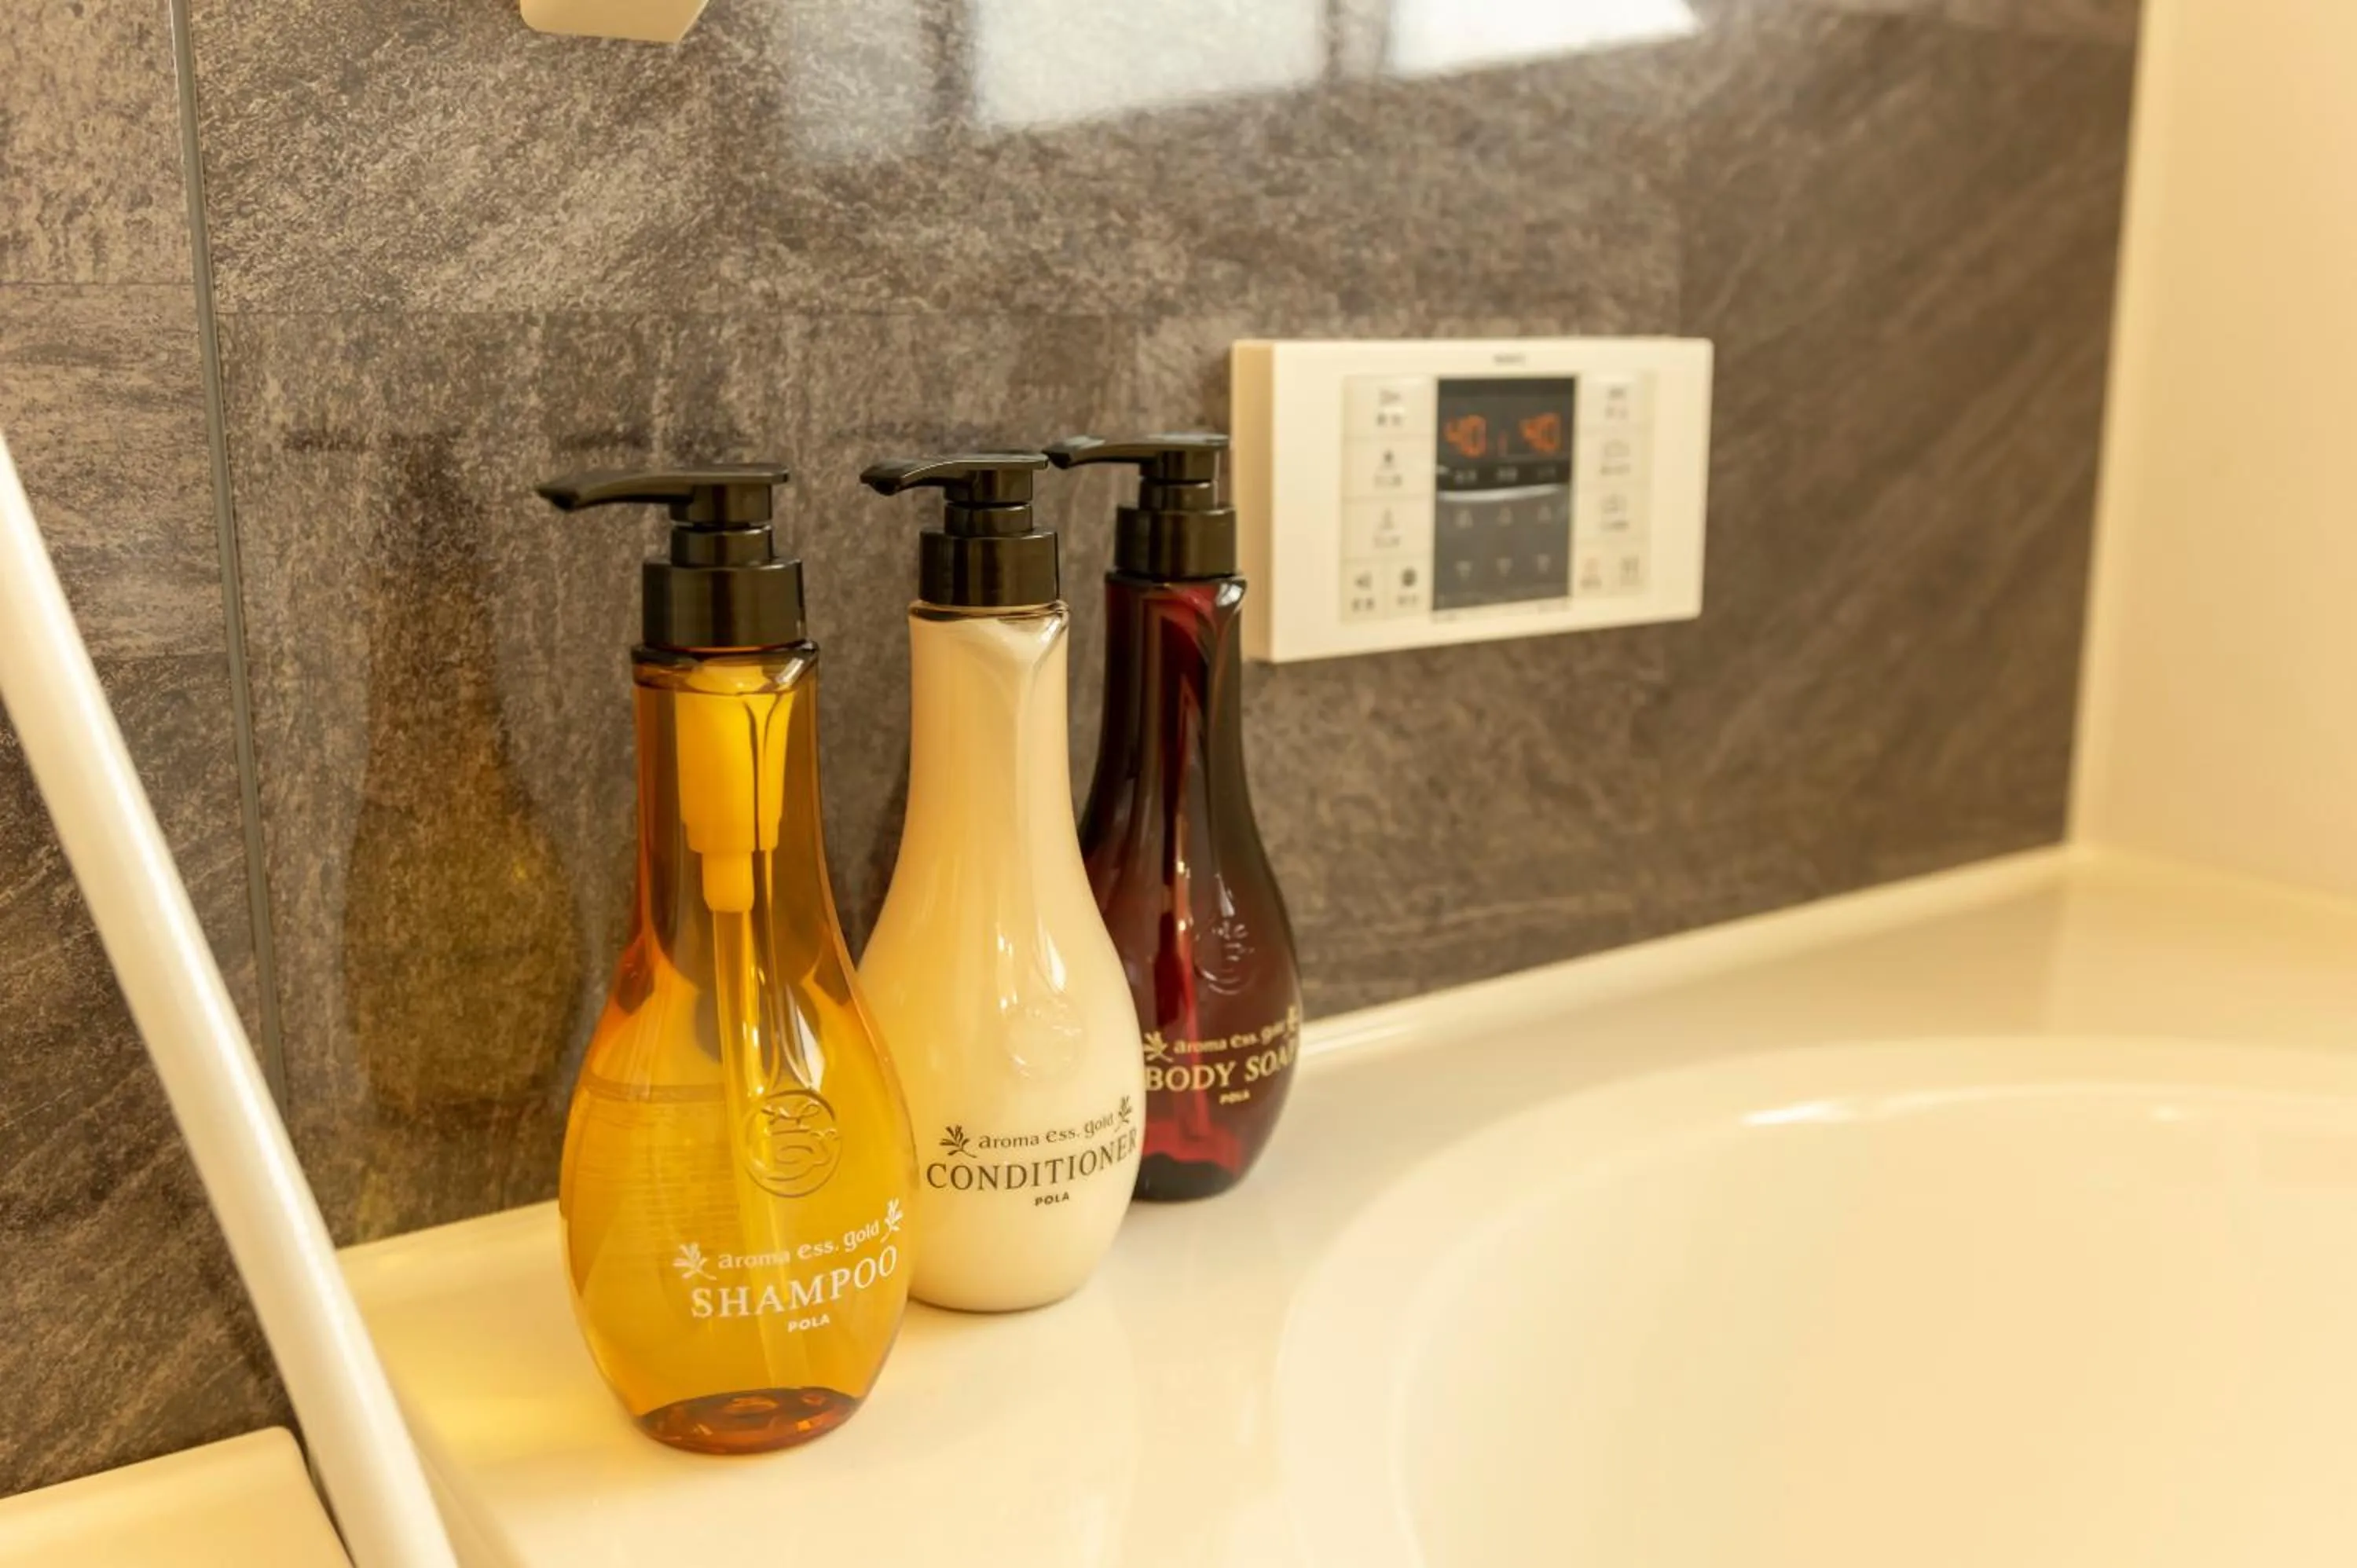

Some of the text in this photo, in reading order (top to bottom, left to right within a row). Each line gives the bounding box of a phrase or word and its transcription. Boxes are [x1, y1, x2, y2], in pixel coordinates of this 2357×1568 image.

[1174, 1039, 1227, 1054] aroma
[1146, 1061, 1236, 1092] BODY
[978, 1112, 1114, 1149] aroma ess. gold
[926, 1127, 1138, 1191] CONDITIONER
[1034, 1191, 1070, 1207] POLA
[718, 1220, 880, 1269] aroma ess. gold
[691, 1244, 898, 1318] SHAMPOO
[787, 1313, 830, 1332] POLA
